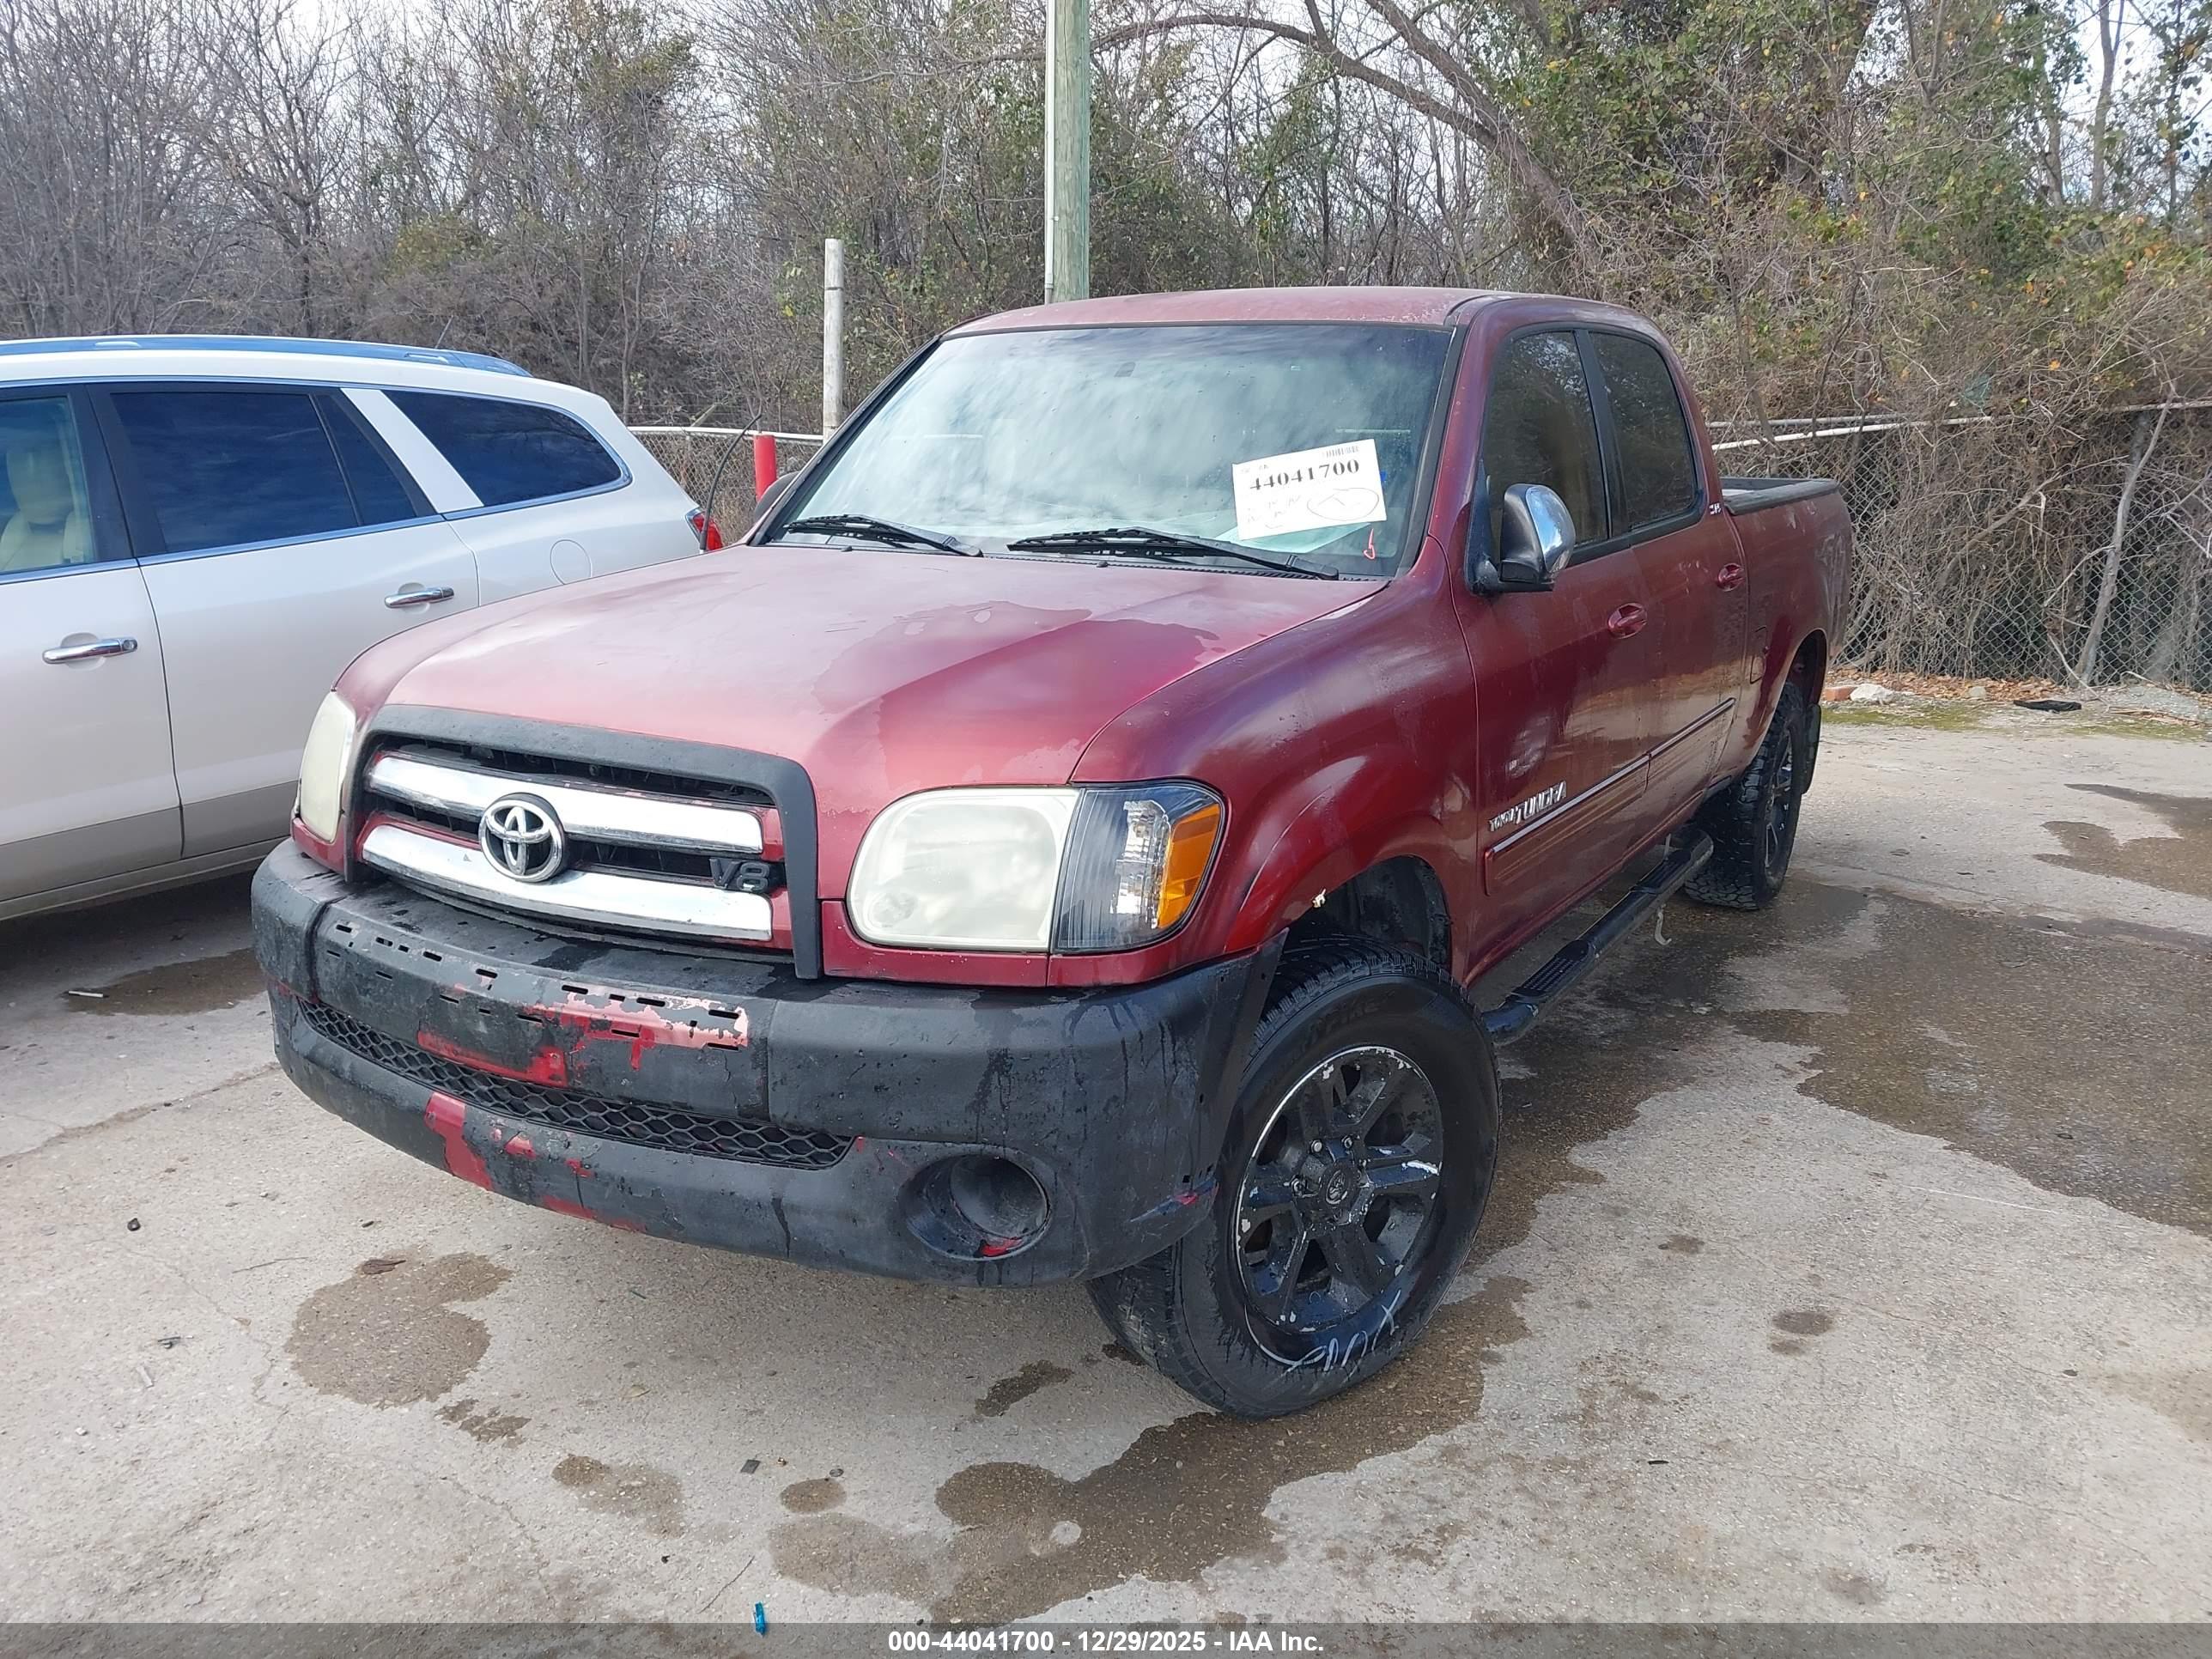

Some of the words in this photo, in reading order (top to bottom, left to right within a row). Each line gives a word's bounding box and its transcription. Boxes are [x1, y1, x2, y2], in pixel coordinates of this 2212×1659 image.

[1249, 459, 1359, 491] 44041700
[1516, 780, 1566, 824] TUNDRA
[708, 857, 769, 894] V8
